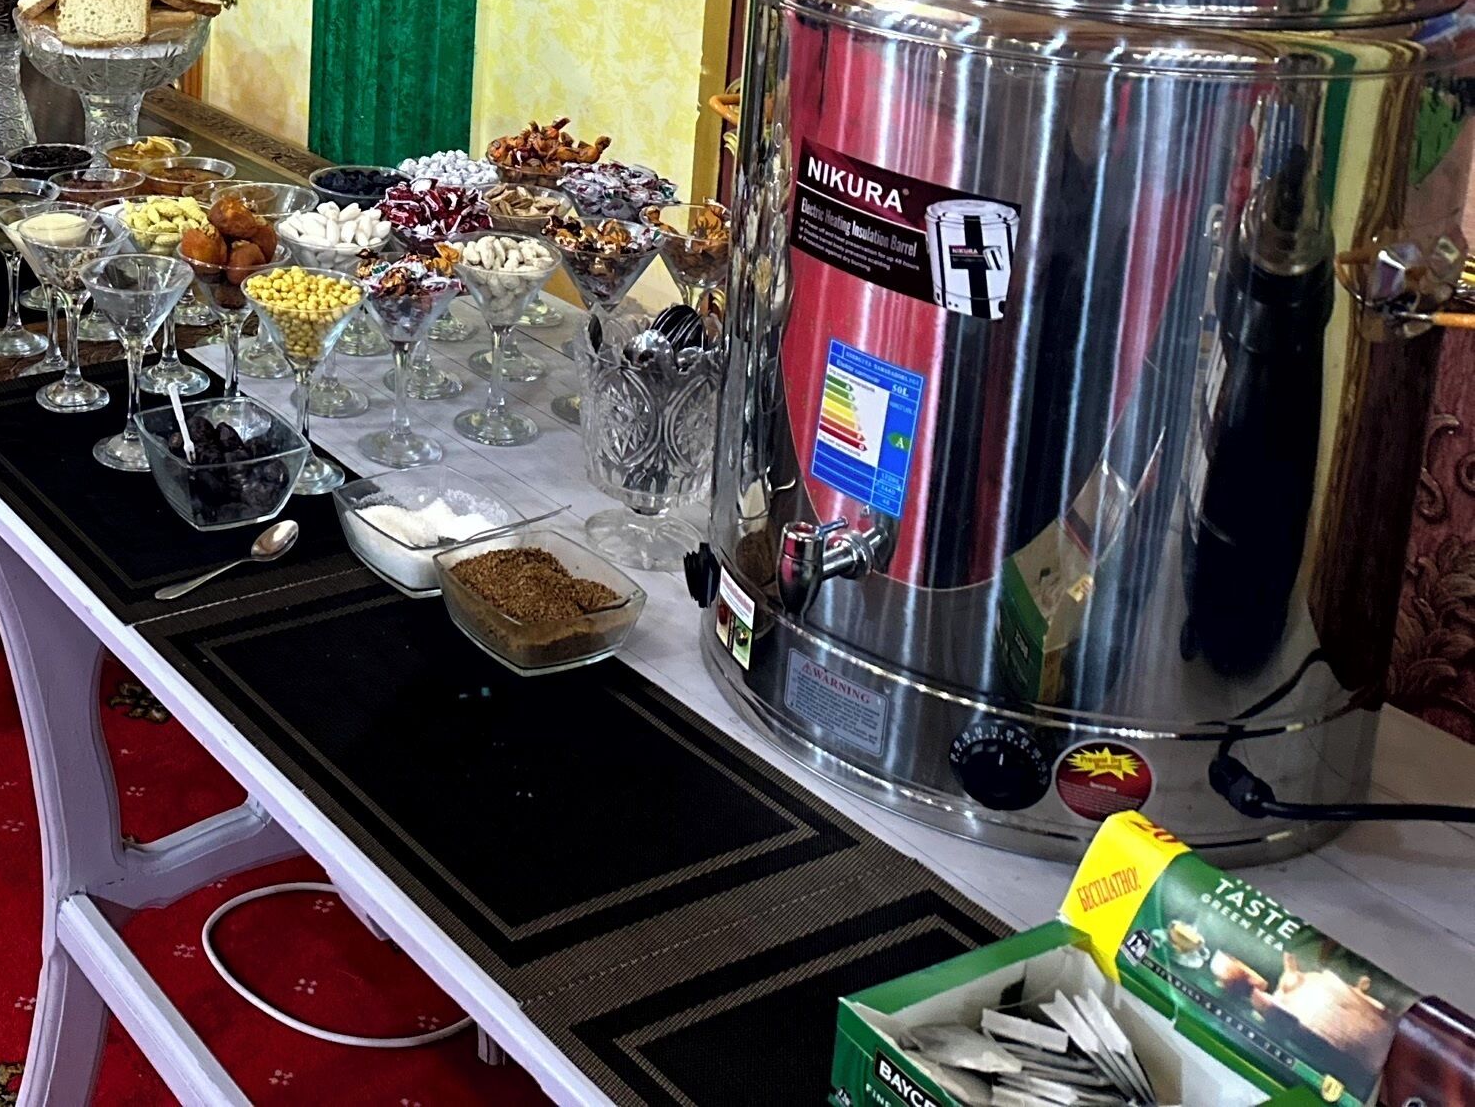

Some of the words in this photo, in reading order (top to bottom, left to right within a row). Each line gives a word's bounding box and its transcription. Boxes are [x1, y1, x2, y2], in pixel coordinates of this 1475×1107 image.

[807, 156, 903, 213] NIKURA
[801, 197, 824, 221] Electric
[825, 209, 851, 236] Heating
[852, 220, 889, 249] Insulation
[890, 234, 917, 258] Barrel
[895, 436, 905, 450] A
[813, 668, 870, 704] WARNING
[1076, 866, 1142, 912] БЕСПЛАТНО!
[1215, 877, 1301, 940] TASTE
[1200, 892, 1252, 929] GREEN
[1256, 927, 1284, 952] TEA
